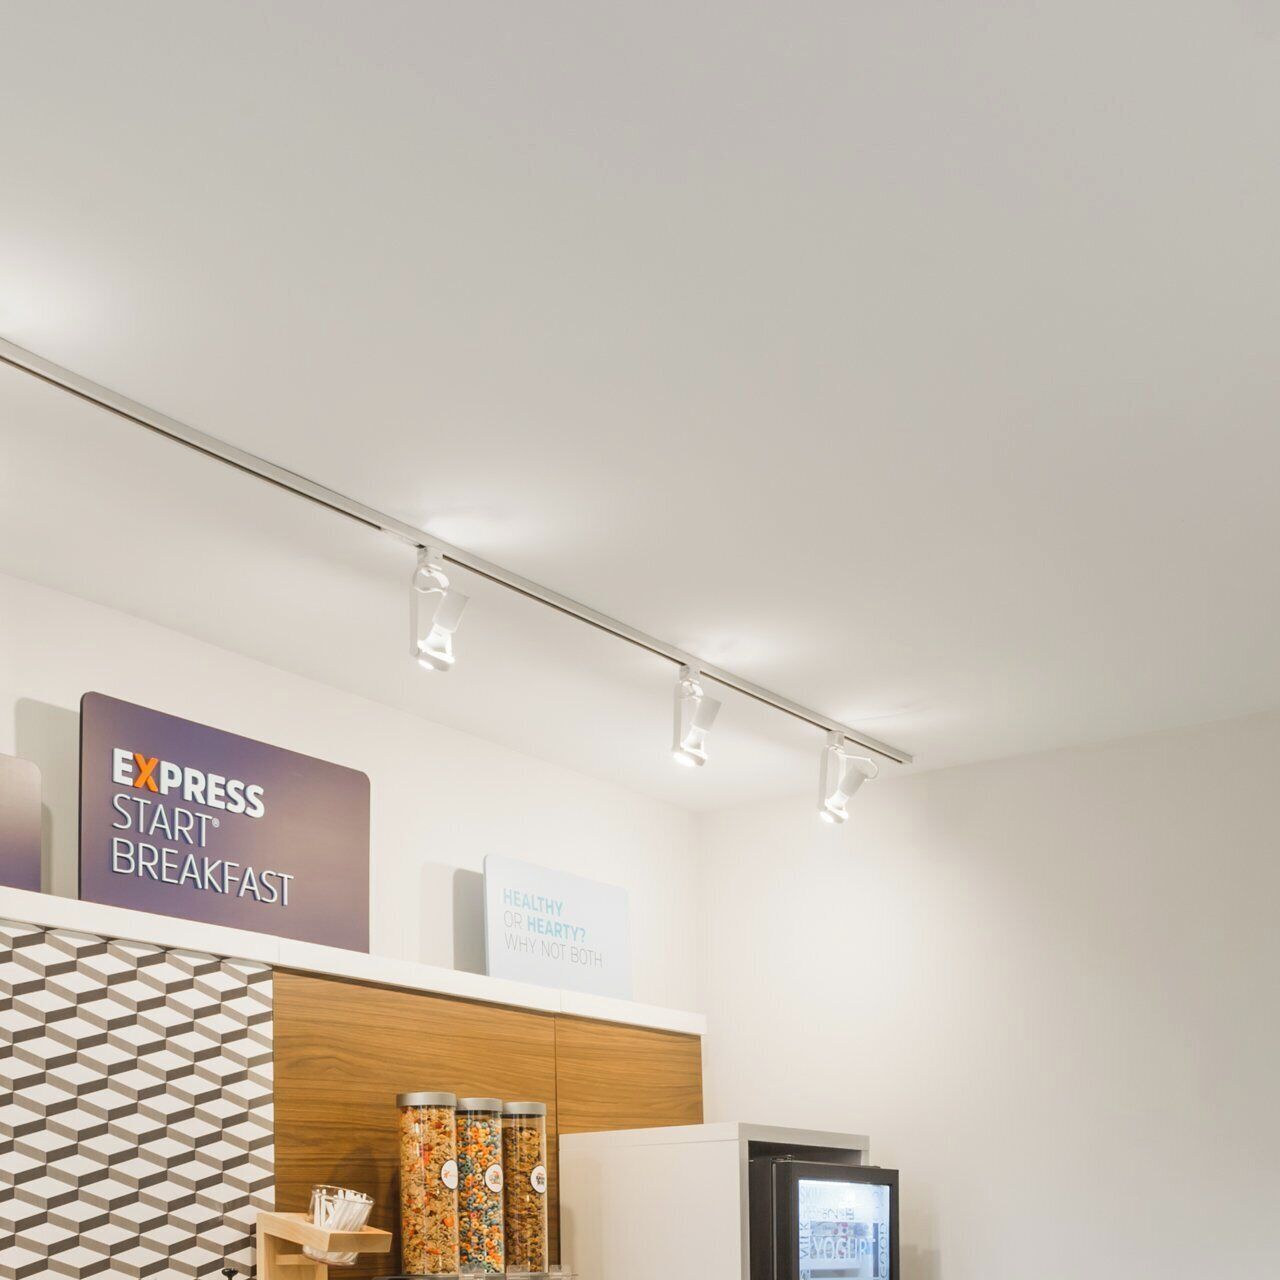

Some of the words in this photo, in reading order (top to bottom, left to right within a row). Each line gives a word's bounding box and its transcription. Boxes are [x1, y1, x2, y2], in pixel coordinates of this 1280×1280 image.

[112, 747, 266, 819] EXPRESS
[111, 837, 295, 907] BREAKFAST
[503, 887, 564, 917] HEALTHY
[503, 910, 523, 929] OR
[527, 915, 586, 943] HEARTY?
[505, 931, 537, 954] WHY
[541, 940, 567, 960] NOT
[570, 946, 603, 968] BOTH
